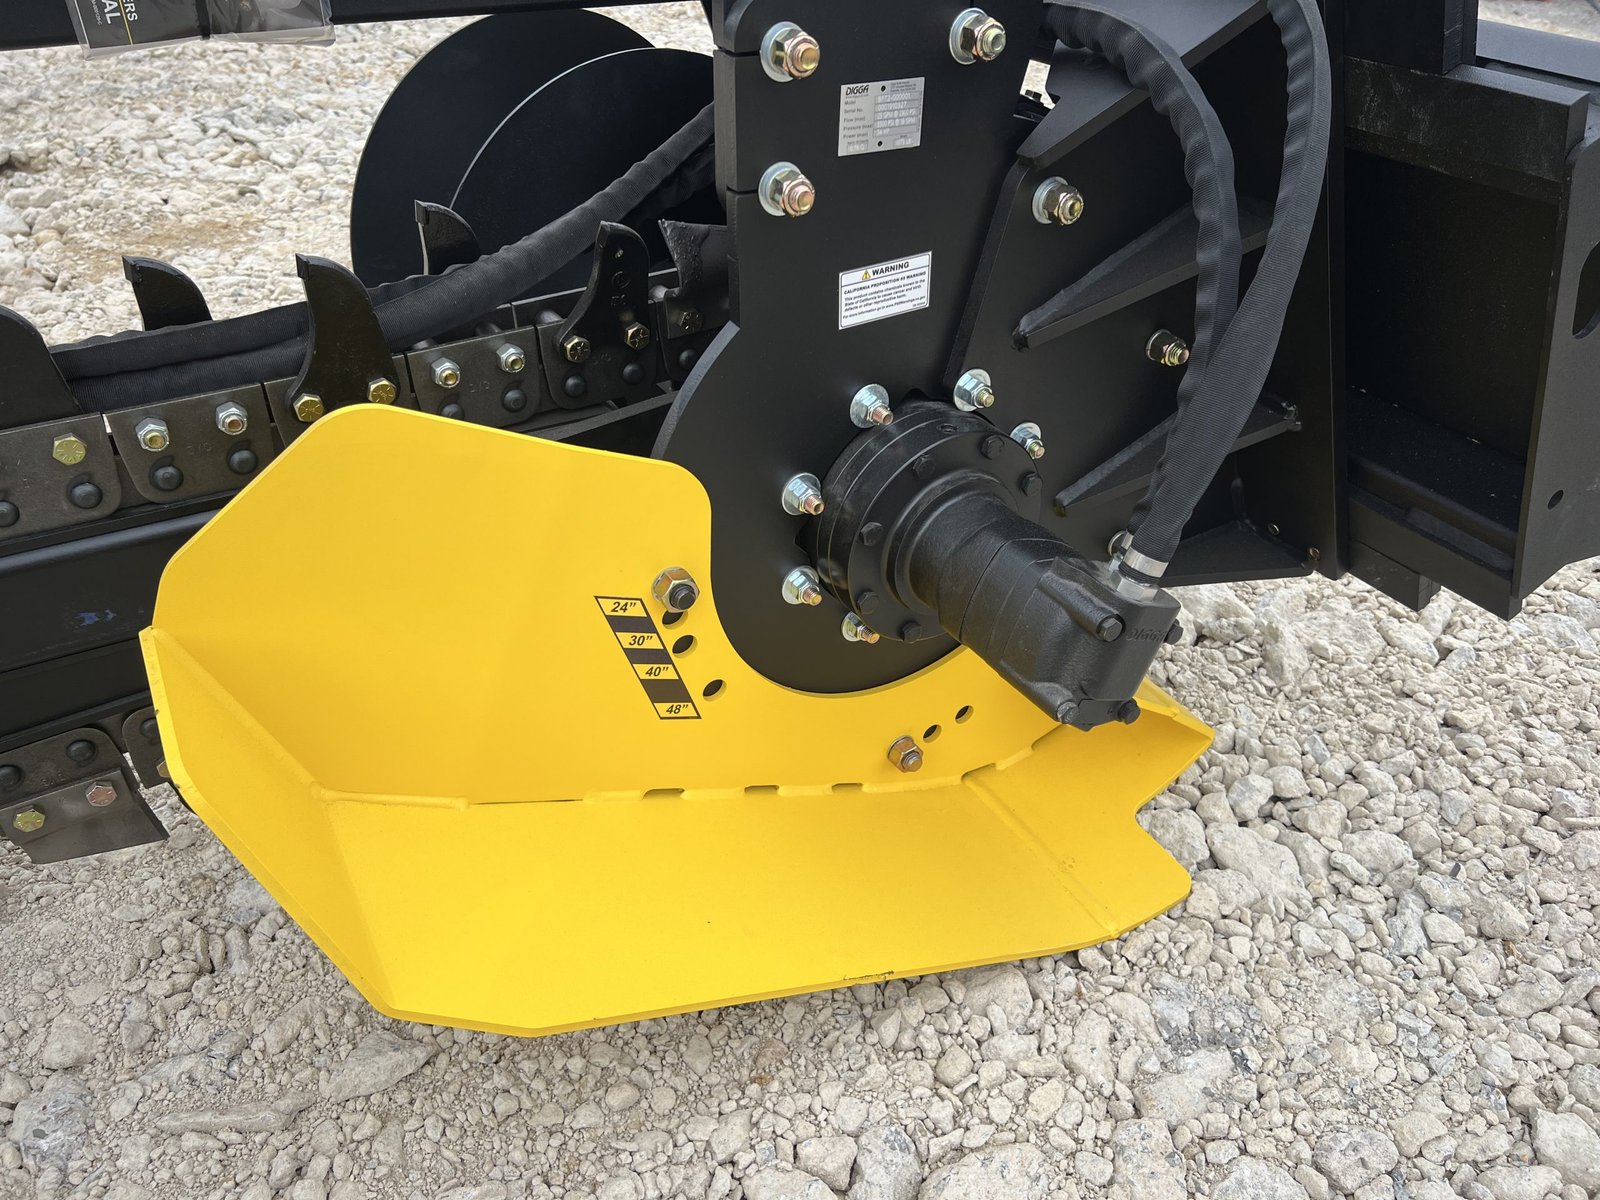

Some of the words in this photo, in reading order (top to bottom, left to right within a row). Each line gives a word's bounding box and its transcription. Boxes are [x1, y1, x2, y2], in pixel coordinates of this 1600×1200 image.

[124, 0, 138, 21] RS
[845, 85, 869, 96] DIGGA
[872, 261, 910, 276] WARNING
[844, 285, 870, 295] CALIFORNIA
[871, 278, 899, 288] PROPOSITION
[907, 272, 926, 280] WARNING
[874, 296, 896, 305] reproductive
